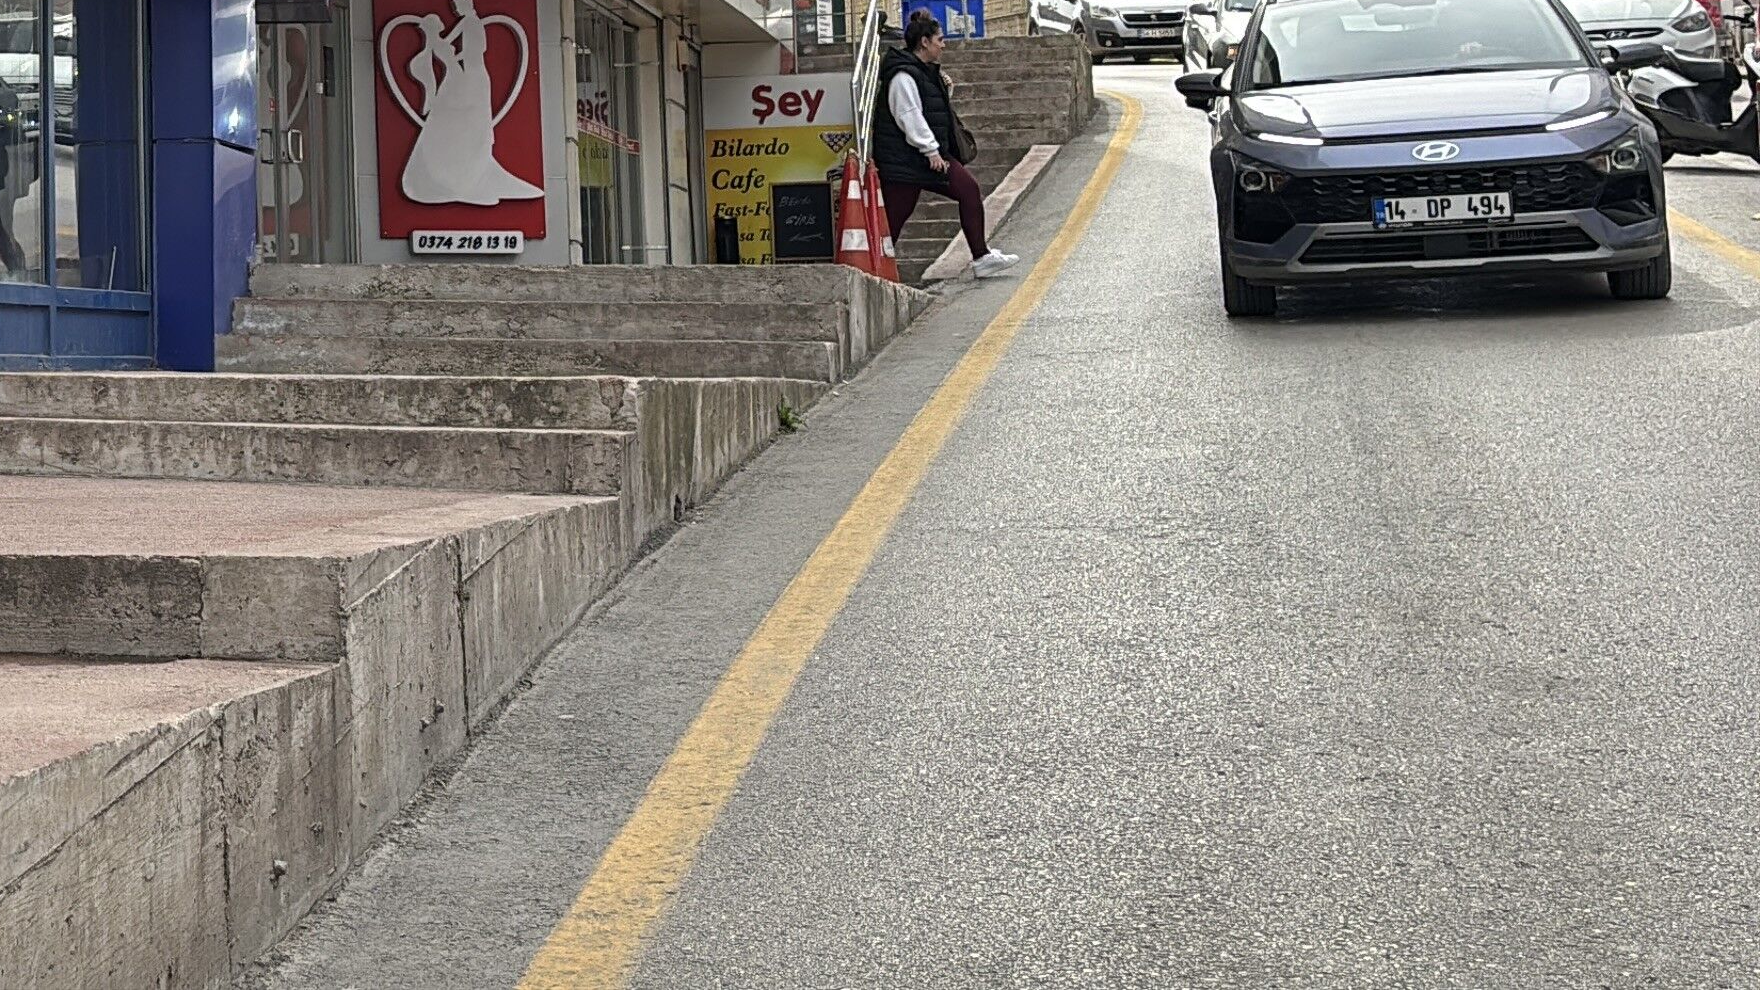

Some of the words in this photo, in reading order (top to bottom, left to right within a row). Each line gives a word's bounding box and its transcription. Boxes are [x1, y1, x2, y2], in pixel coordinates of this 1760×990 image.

[751, 84, 825, 125] Şey
[711, 138, 790, 158] Bilardo
[712, 168, 765, 193] Cafe
[1384, 200, 1406, 220] 14
[1426, 198, 1452, 218] DP
[1467, 195, 1506, 216] 494
[418, 236, 453, 249] 0374
[487, 236, 500, 249] 13
